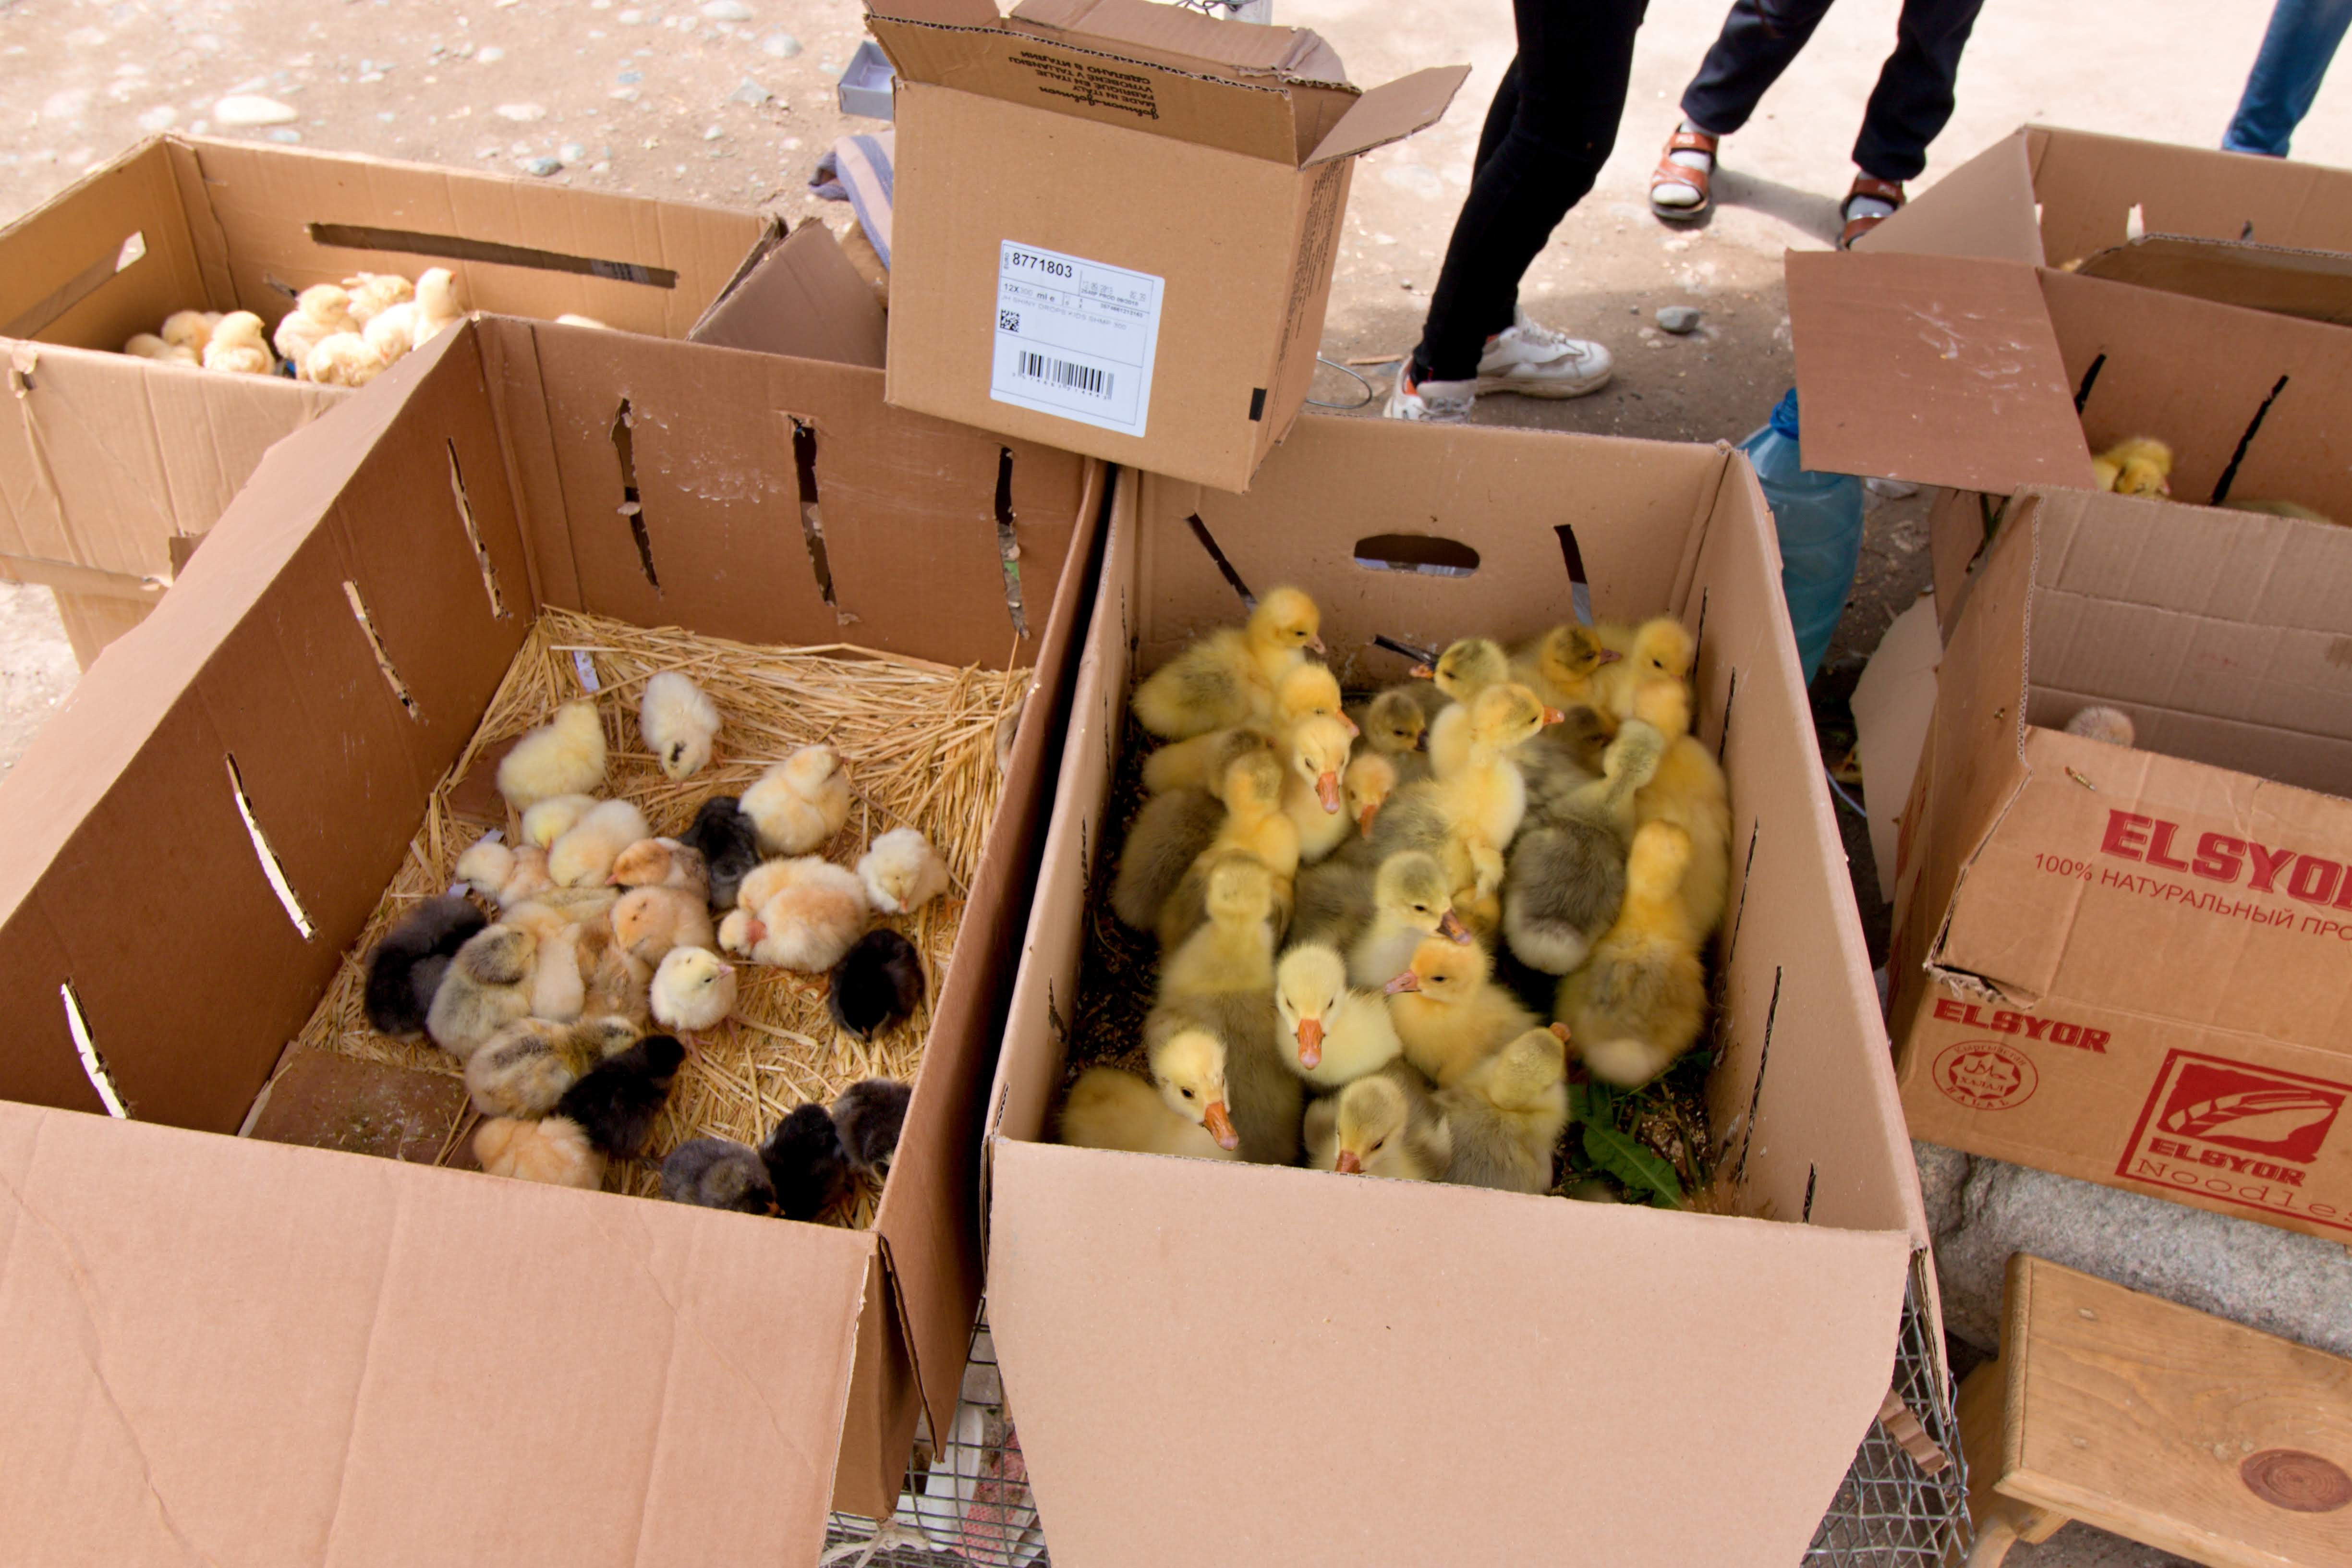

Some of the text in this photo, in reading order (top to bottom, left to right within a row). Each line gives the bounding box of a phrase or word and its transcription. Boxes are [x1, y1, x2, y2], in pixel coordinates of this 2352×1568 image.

[1021, 51, 1071, 68] ИТАЛИИ
[1035, 69, 1072, 82] ITALIE
[1074, 78, 1091, 86] EN
[1087, 66, 1151, 85] СДЕЛАНО
[1073, 85, 1103, 96] ITALY
[1122, 96, 1155, 107] MADE
[1013, 253, 1072, 278] 8771803
[2035, 853, 2352, 941] 100% НАТУРАЛЬНЫЙ ПРО
[1933, 997, 2111, 1054] ELSYOR
[1961, 1076, 2004, 1092] ХАЛАЛ
[1946, 1086, 2009, 1108] HALAL
[2147, 1137, 2306, 1188] ELSYOR
